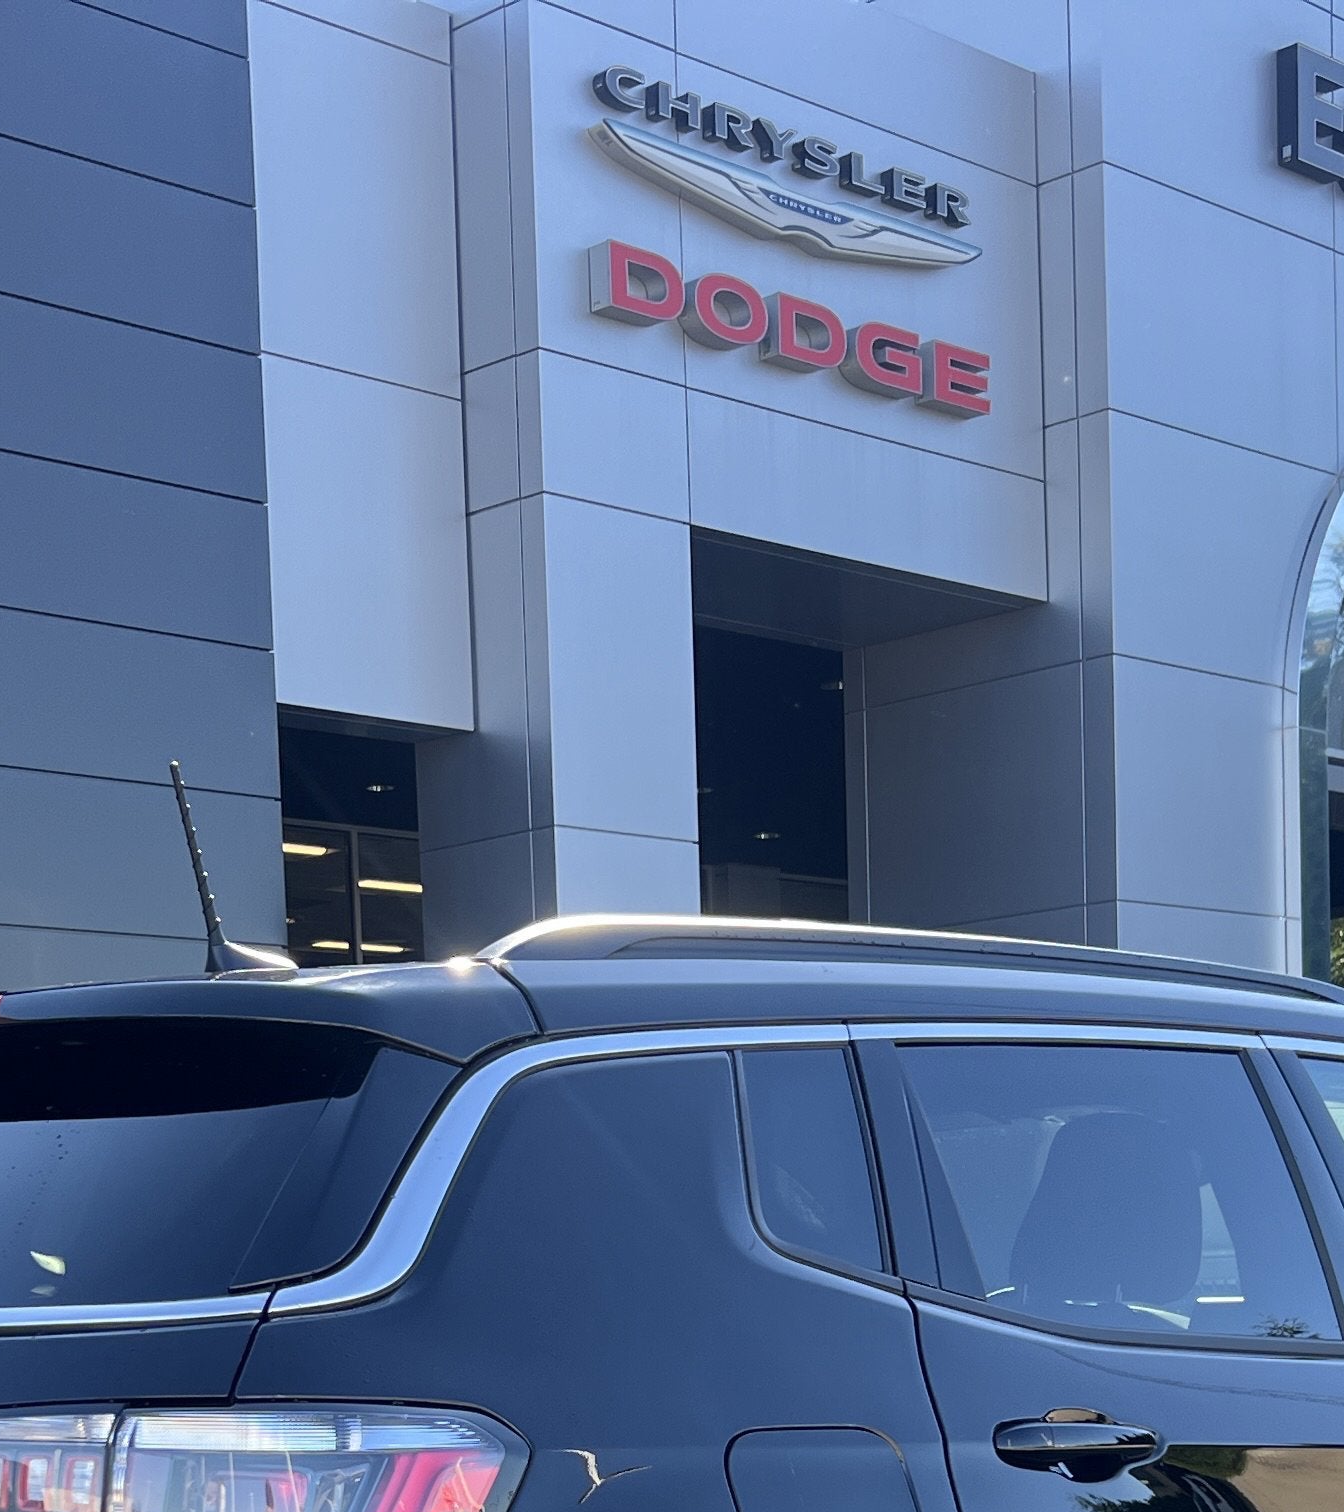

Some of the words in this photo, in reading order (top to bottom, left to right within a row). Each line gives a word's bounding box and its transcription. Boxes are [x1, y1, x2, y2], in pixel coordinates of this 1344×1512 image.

[593, 65, 972, 227] CHRYSLER
[768, 194, 842, 223] CHRYSLER
[588, 239, 992, 419] DODGE
